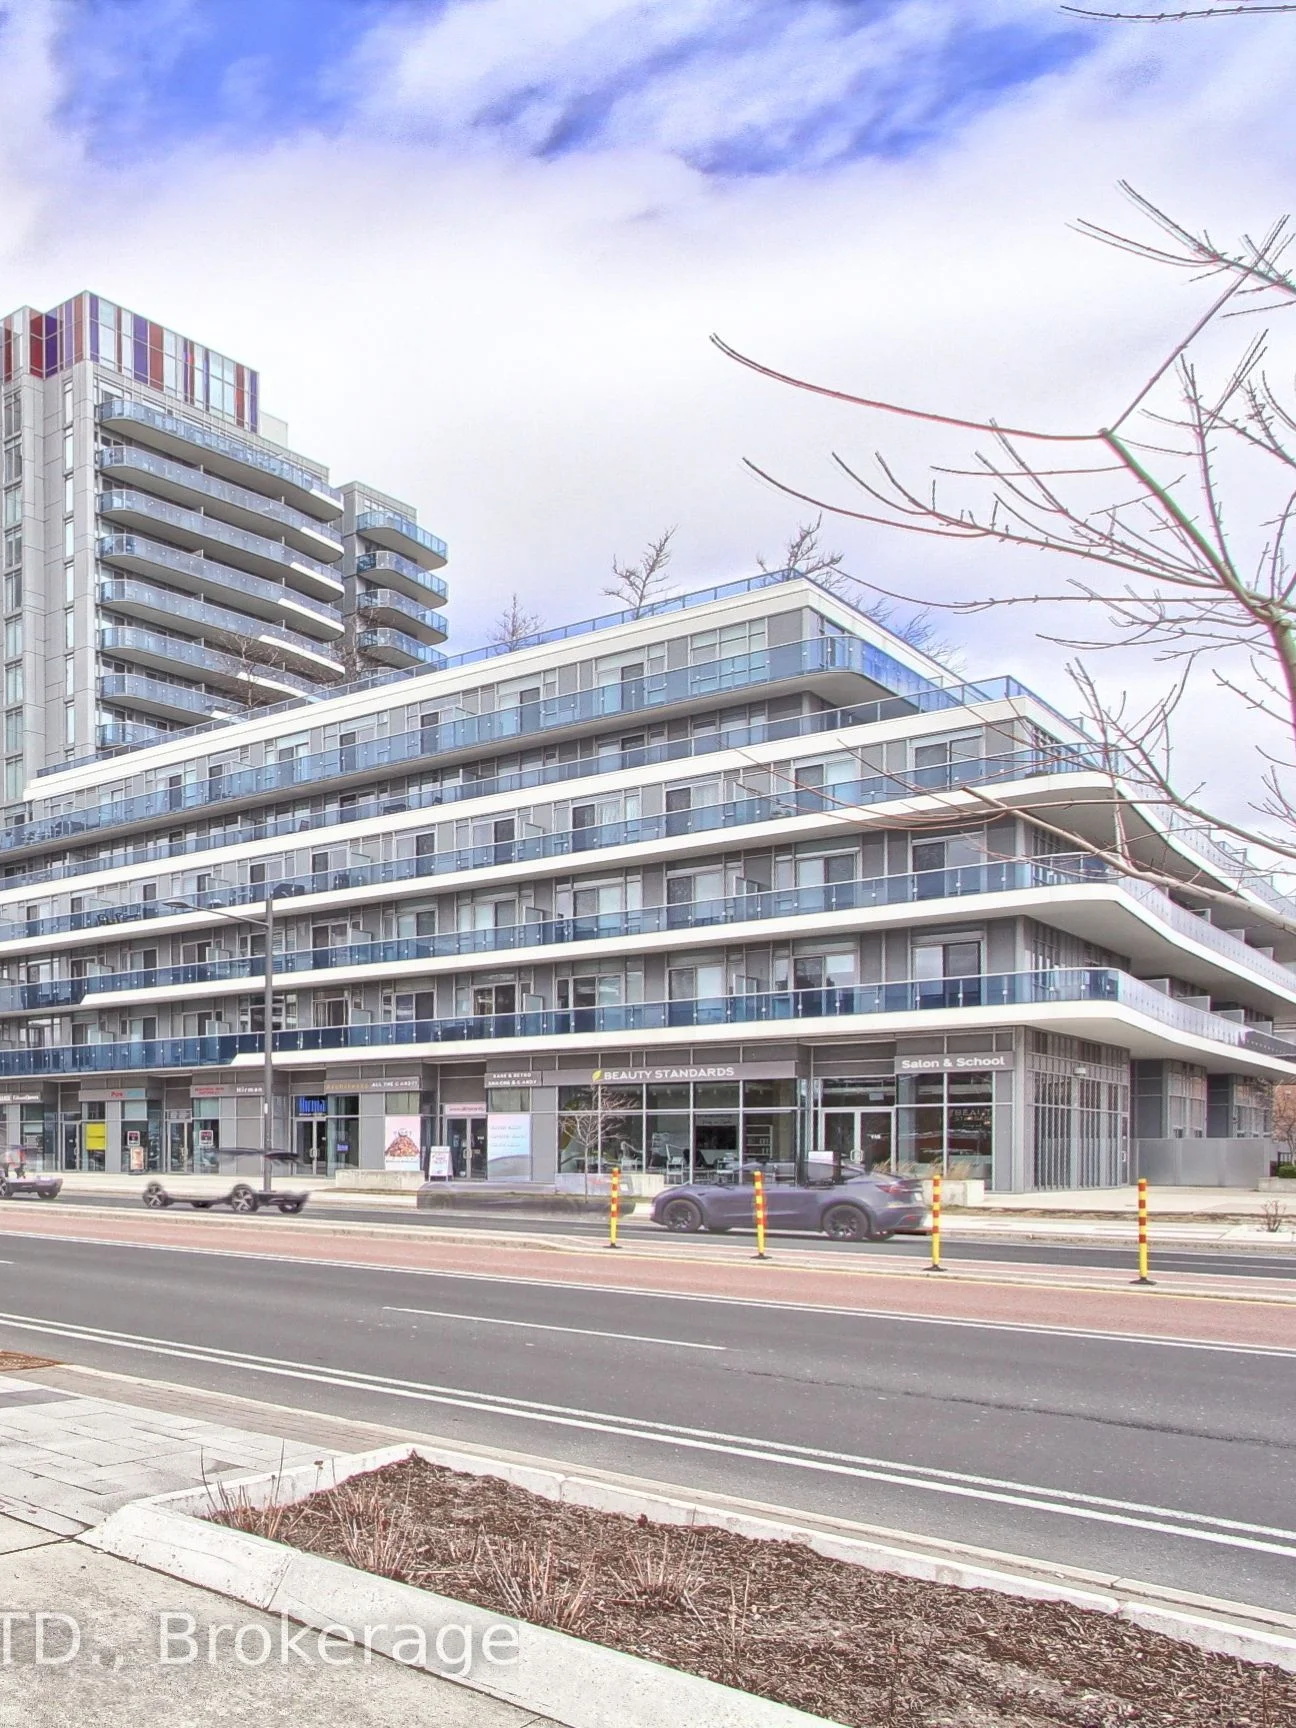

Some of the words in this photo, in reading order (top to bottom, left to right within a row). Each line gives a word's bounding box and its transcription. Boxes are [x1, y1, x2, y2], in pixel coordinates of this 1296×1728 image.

[901, 1059, 940, 1069] Salon
[943, 1058, 953, 1067] &
[956, 1056, 1006, 1067] School
[604, 1070, 652, 1080] BEAUTY
[654, 1067, 735, 1079] STANDARDS
